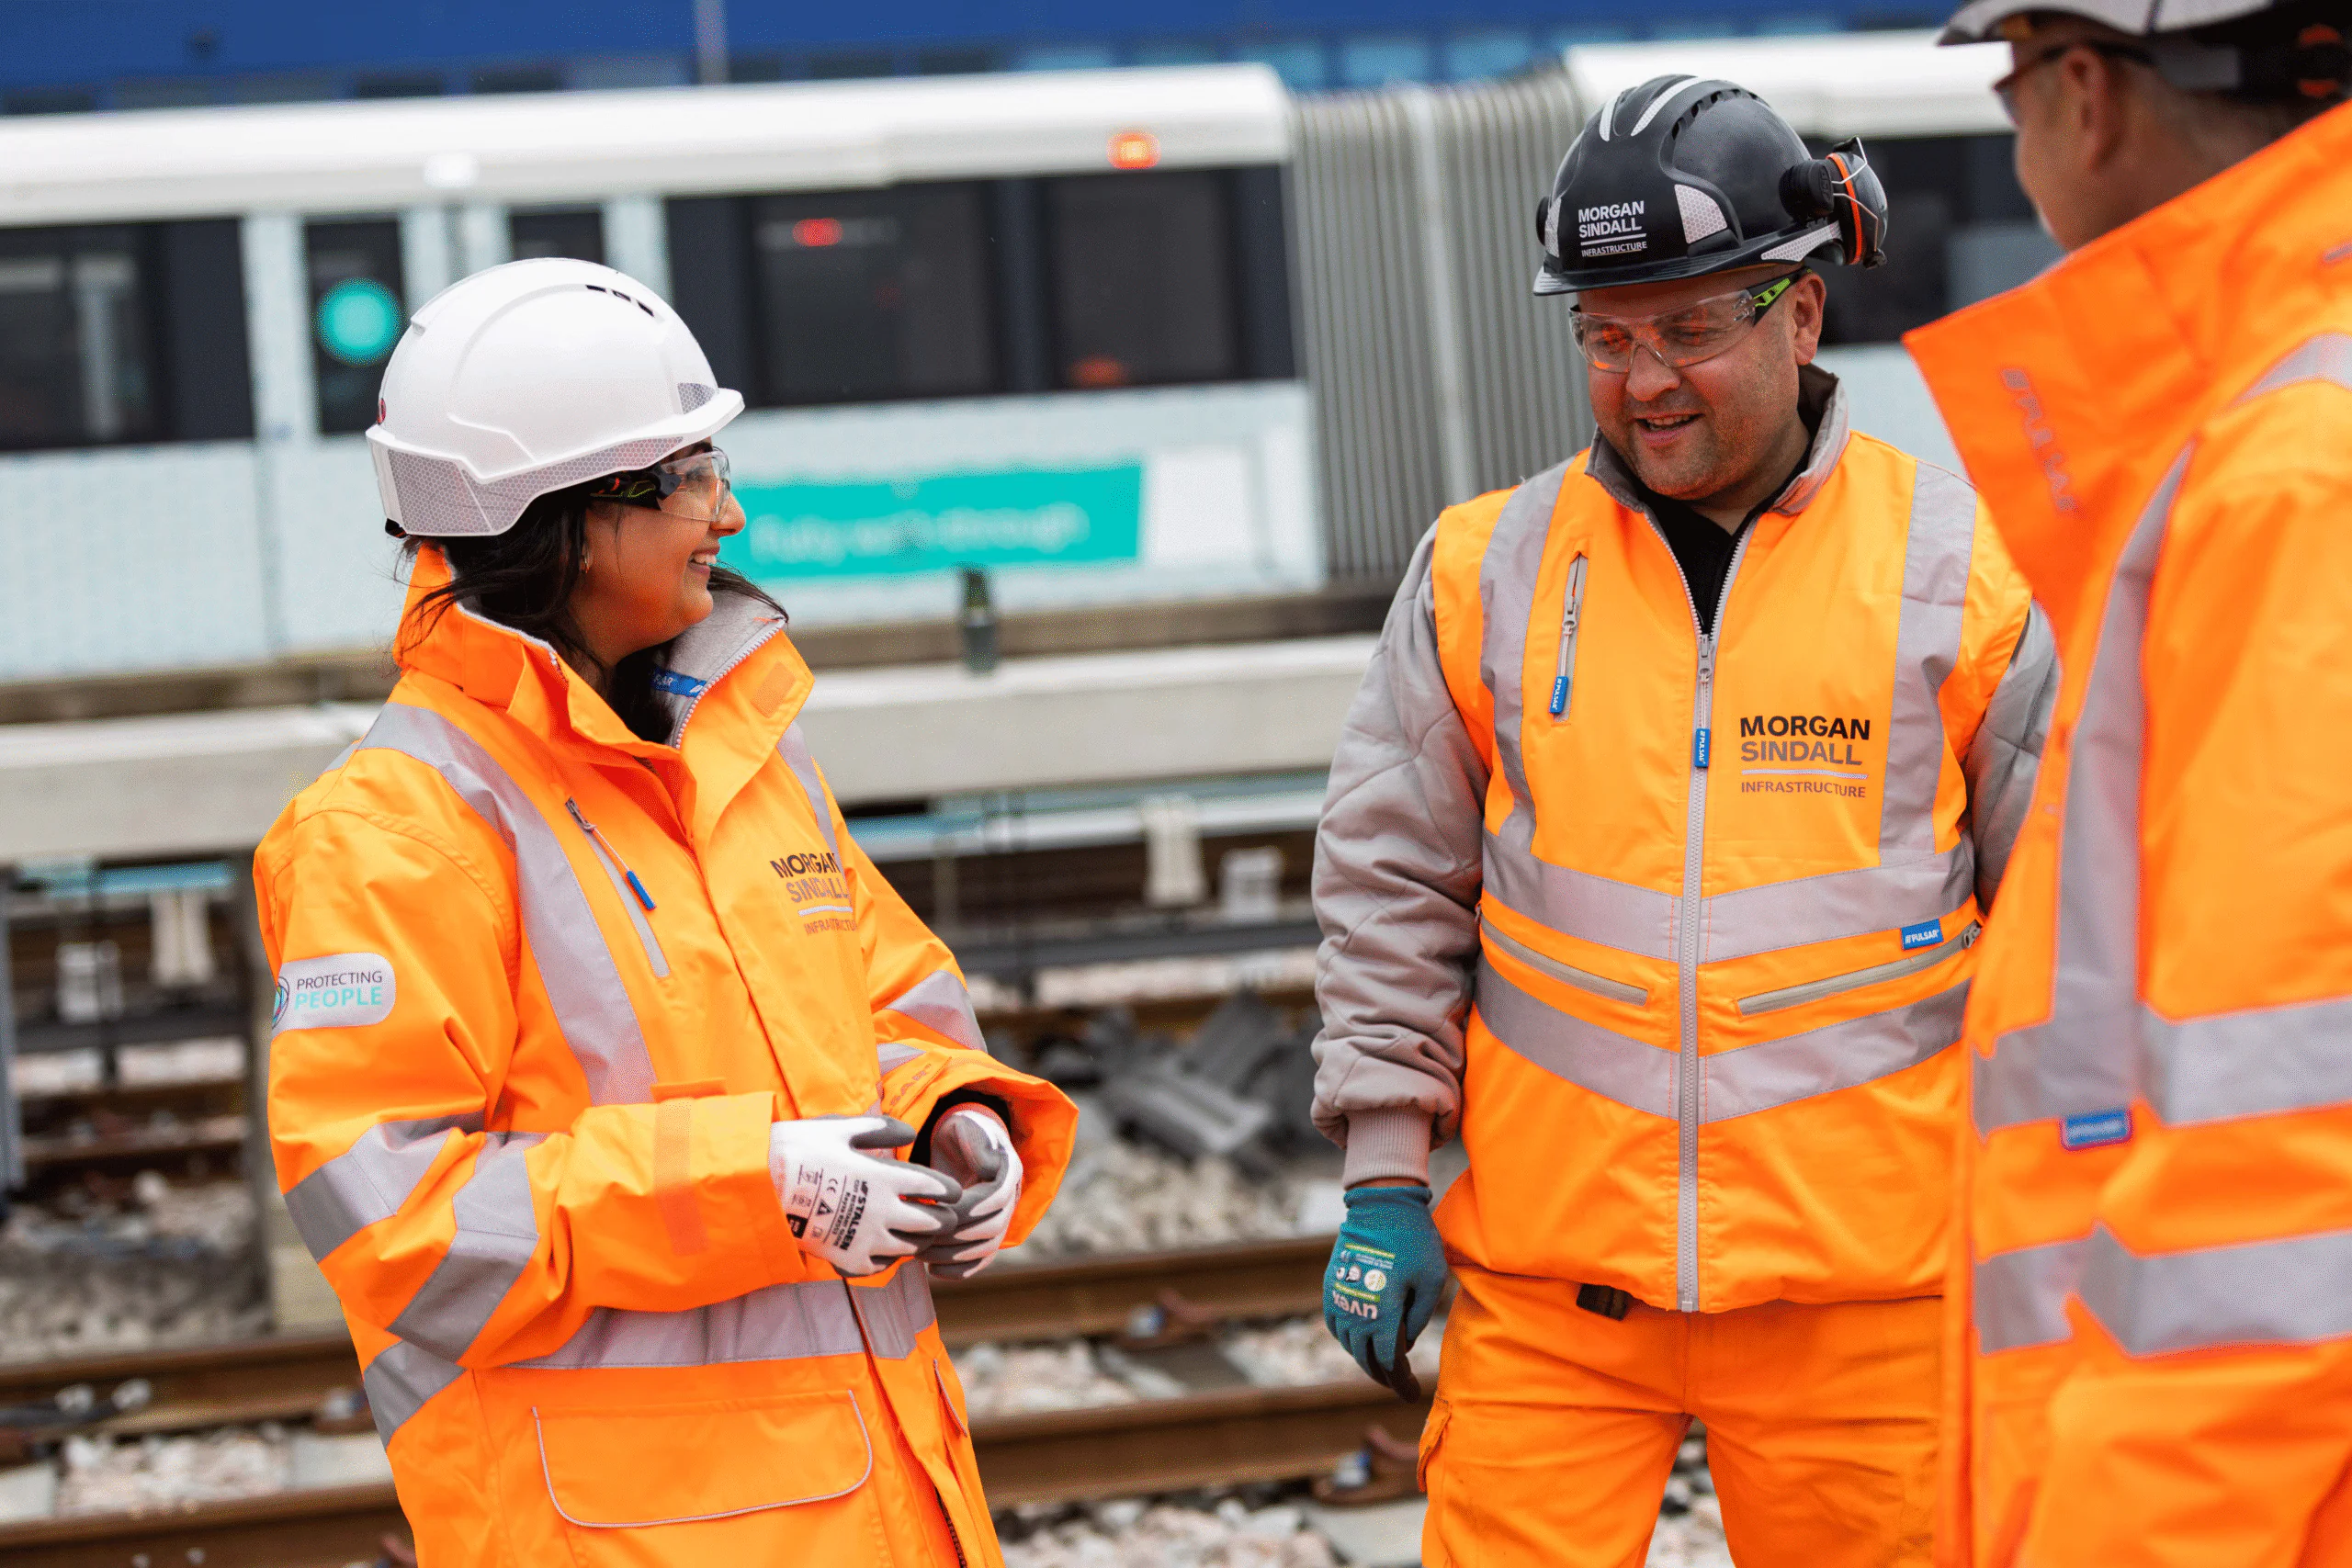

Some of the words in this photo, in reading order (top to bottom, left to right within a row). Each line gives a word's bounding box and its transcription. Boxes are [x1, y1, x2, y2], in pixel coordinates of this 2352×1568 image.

[1577, 200, 1645, 222] MORGAN
[1578, 217, 1643, 238] SINDALL
[1581, 241, 1647, 257] INFRASTRUCTURE
[1740, 715, 1871, 740] MORGAN
[1740, 740, 1862, 765] SINDALL
[1741, 781, 1866, 798] INFRASTRUCTURE
[770, 852, 842, 878] MORGAN
[786, 877, 849, 903] SINDALL
[1911, 929, 1939, 943] PULSAR
[297, 970, 382, 990] PROTECTING
[294, 986, 383, 1010] PEOPLE
[840, 1196, 866, 1250] STALSEN
[1332, 1290, 1378, 1320] uvex
